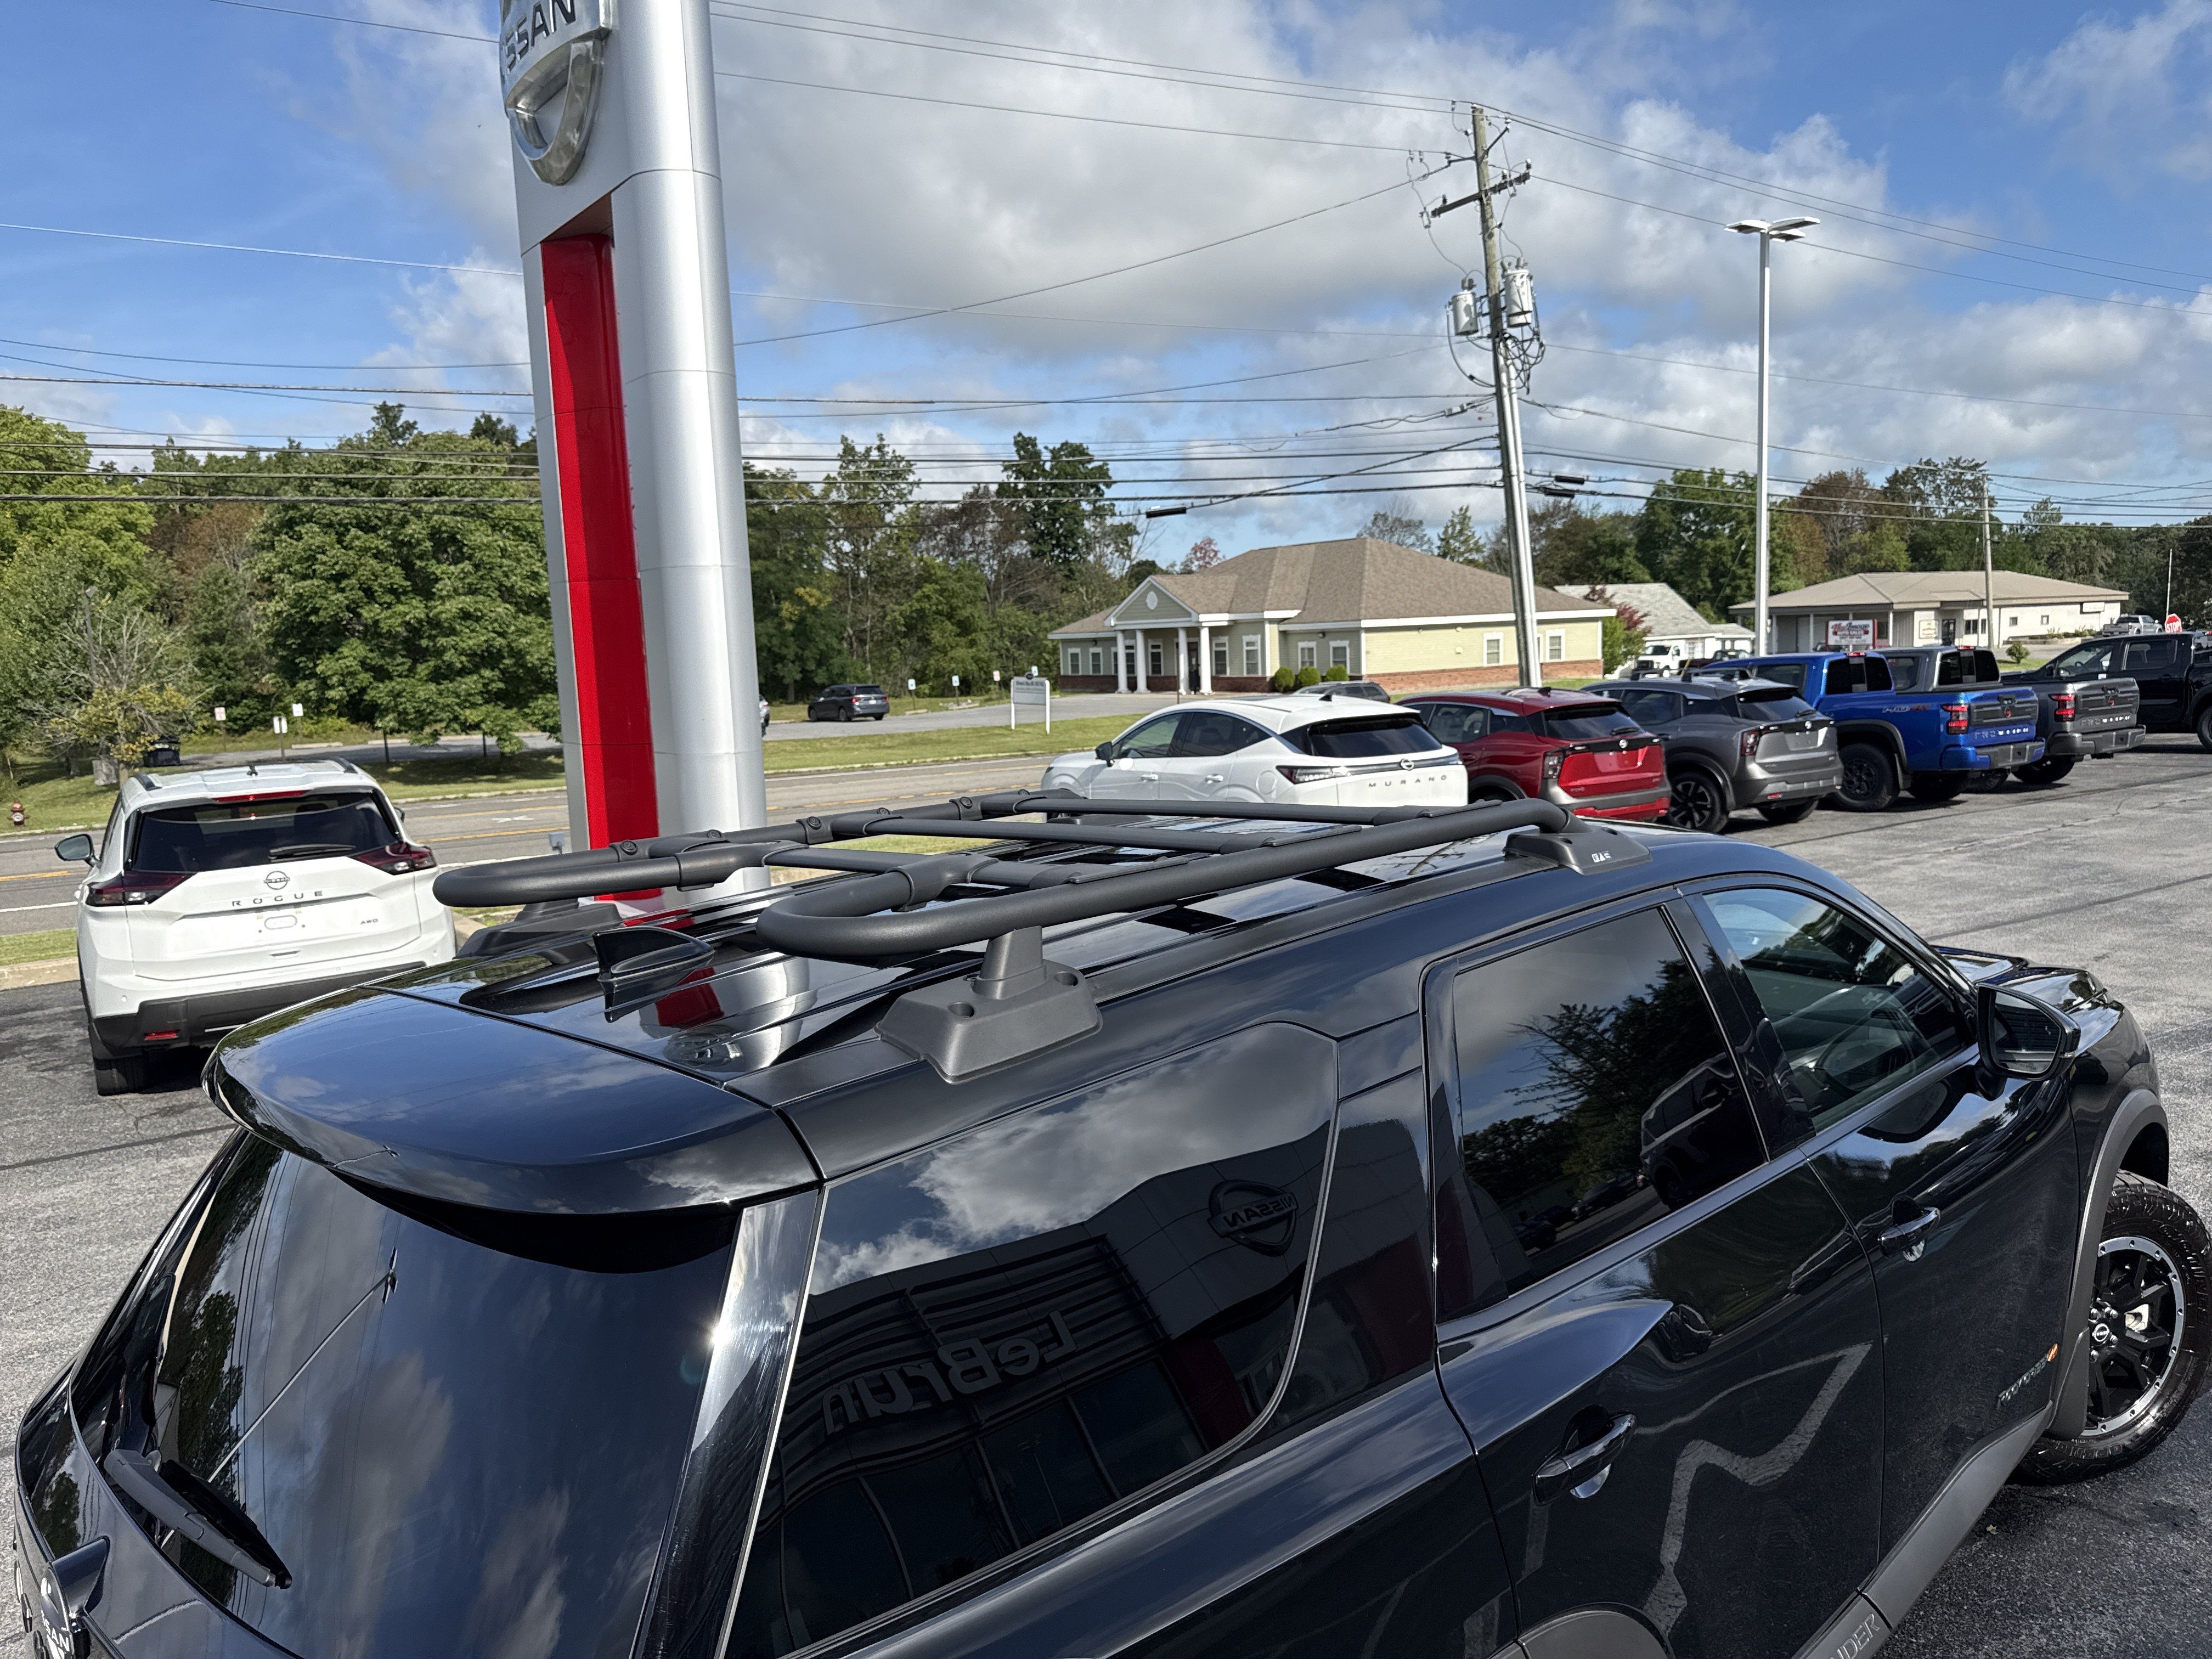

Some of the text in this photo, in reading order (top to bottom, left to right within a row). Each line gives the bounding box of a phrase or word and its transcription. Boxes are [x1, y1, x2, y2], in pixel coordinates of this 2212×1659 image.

[2166, 620, 2181, 633] STOP
[1368, 775, 1447, 787] MURANO
[232, 890, 323, 906] ROGUE
